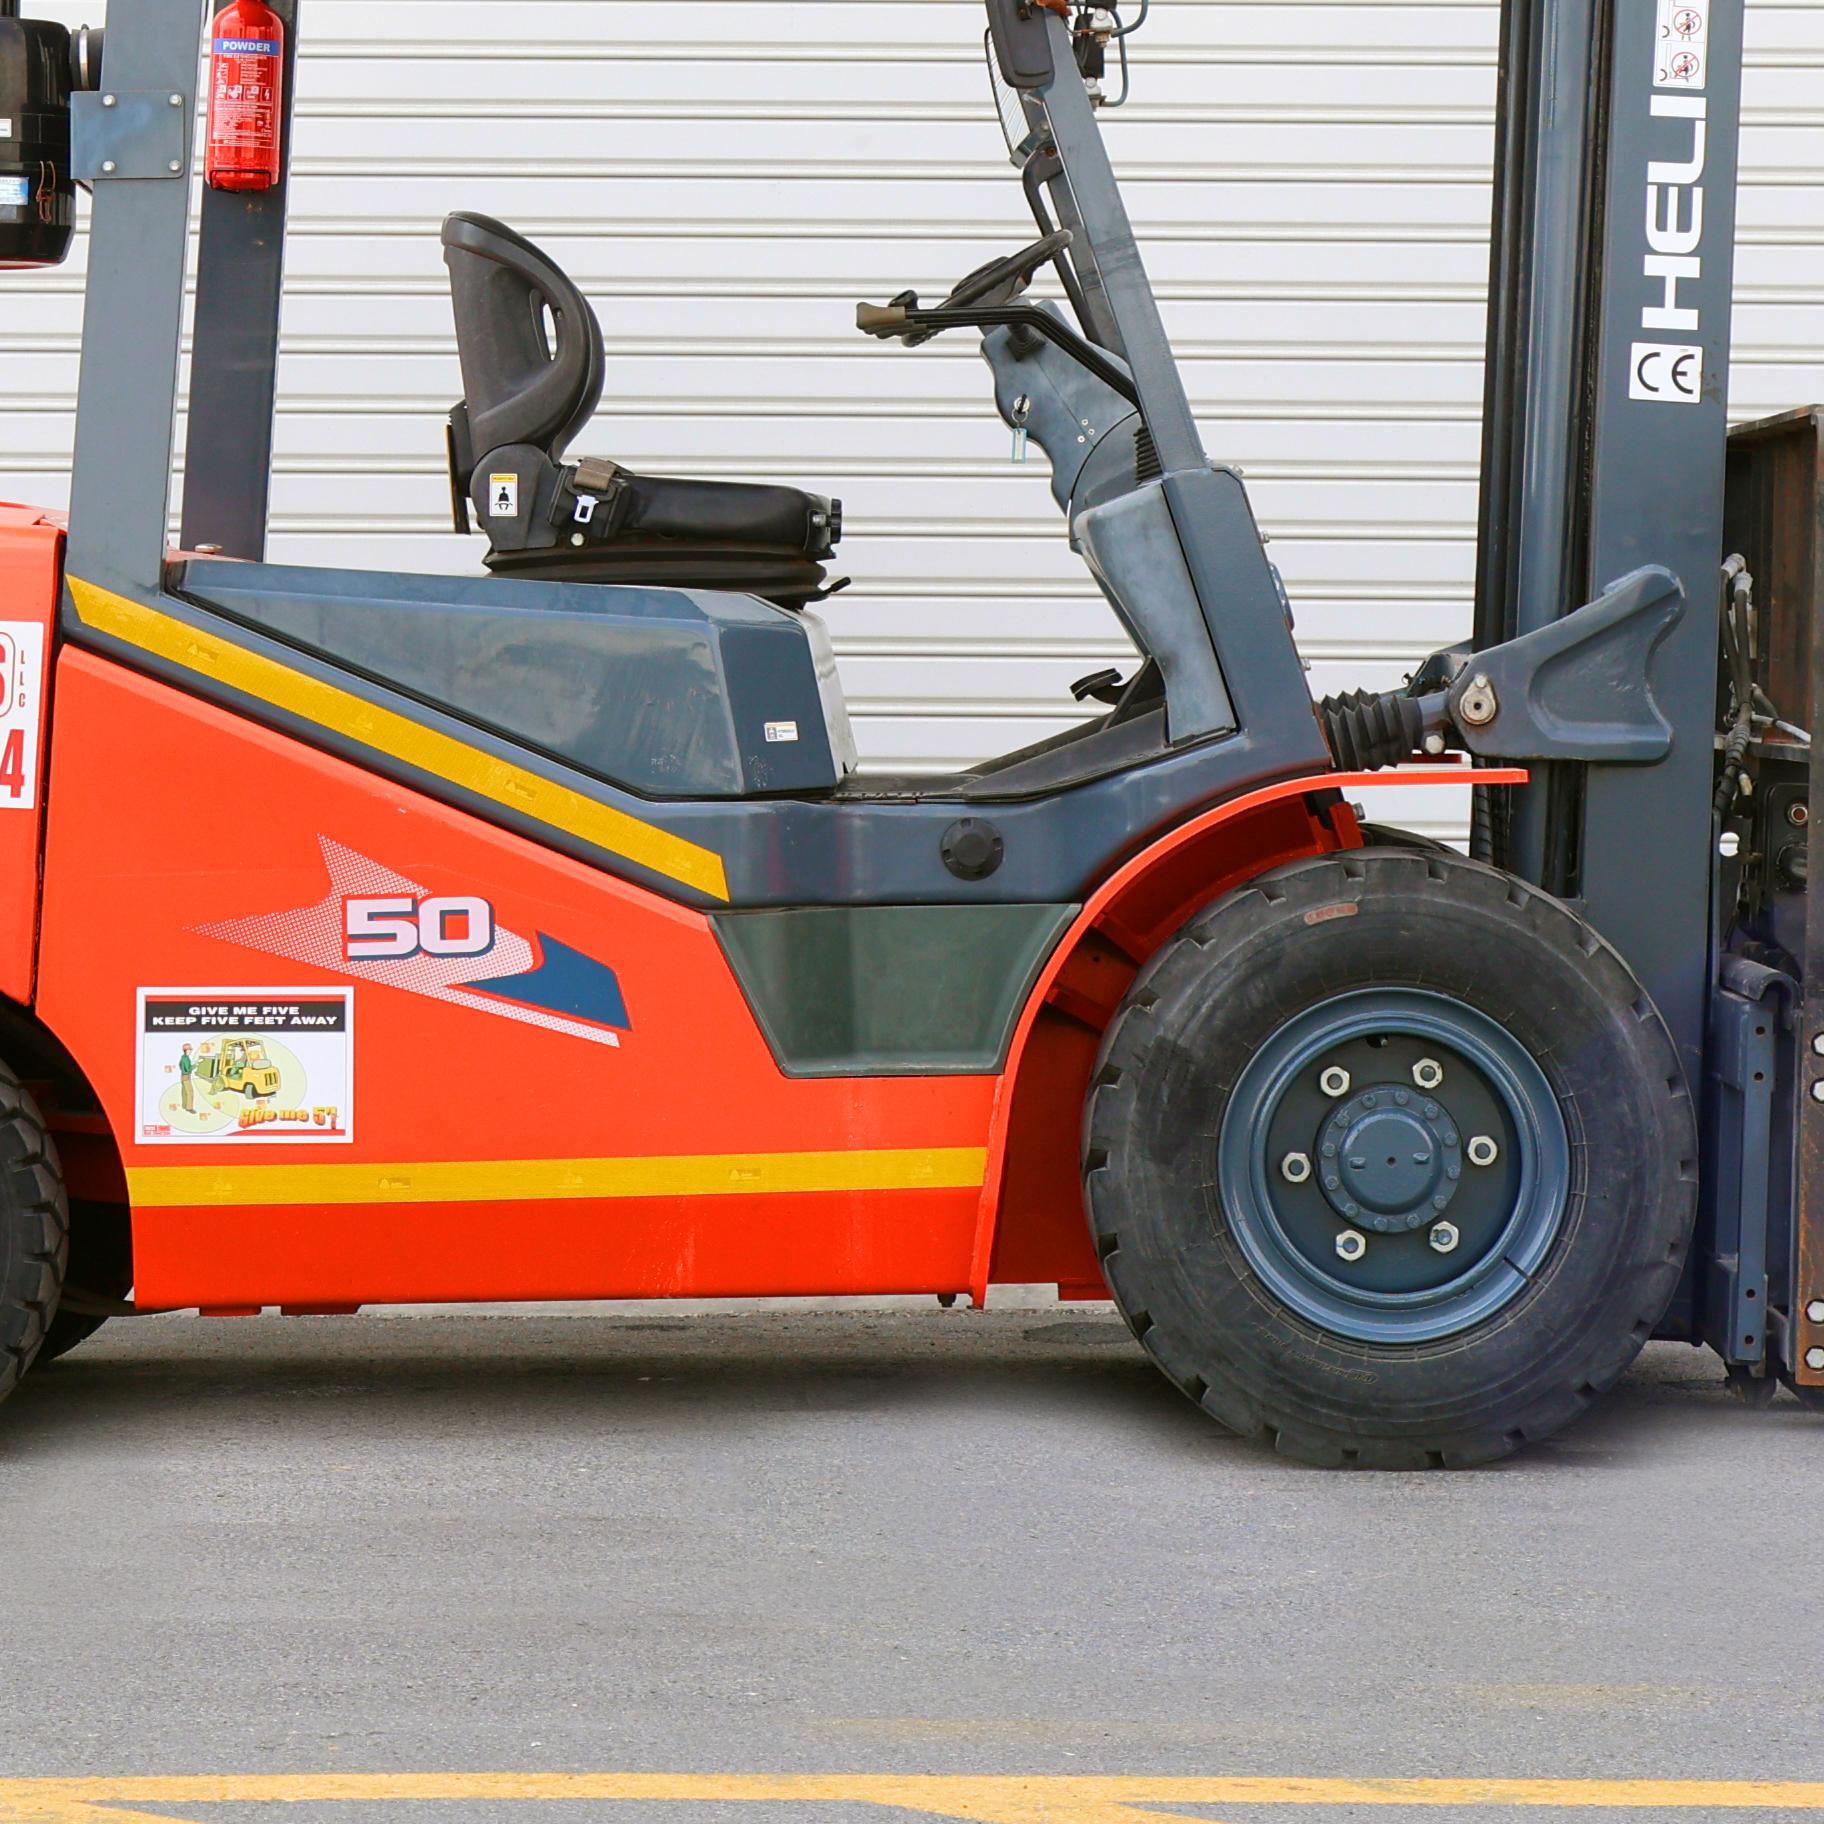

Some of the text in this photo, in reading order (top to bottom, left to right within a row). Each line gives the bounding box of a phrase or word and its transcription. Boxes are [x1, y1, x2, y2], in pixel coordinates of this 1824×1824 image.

[222, 41, 271, 52] POWDER
[1641, 94, 1707, 331] HELI
[1637, 351, 1696, 395] CE
[18, 649, 26, 708] LLC
[345, 895, 495, 961] 50
[152, 1016, 338, 1026] KEEP FIVE FEET AWAY
[188, 1006, 300, 1016] GIVE ME FIVE
[279, 1109, 309, 1122] me
